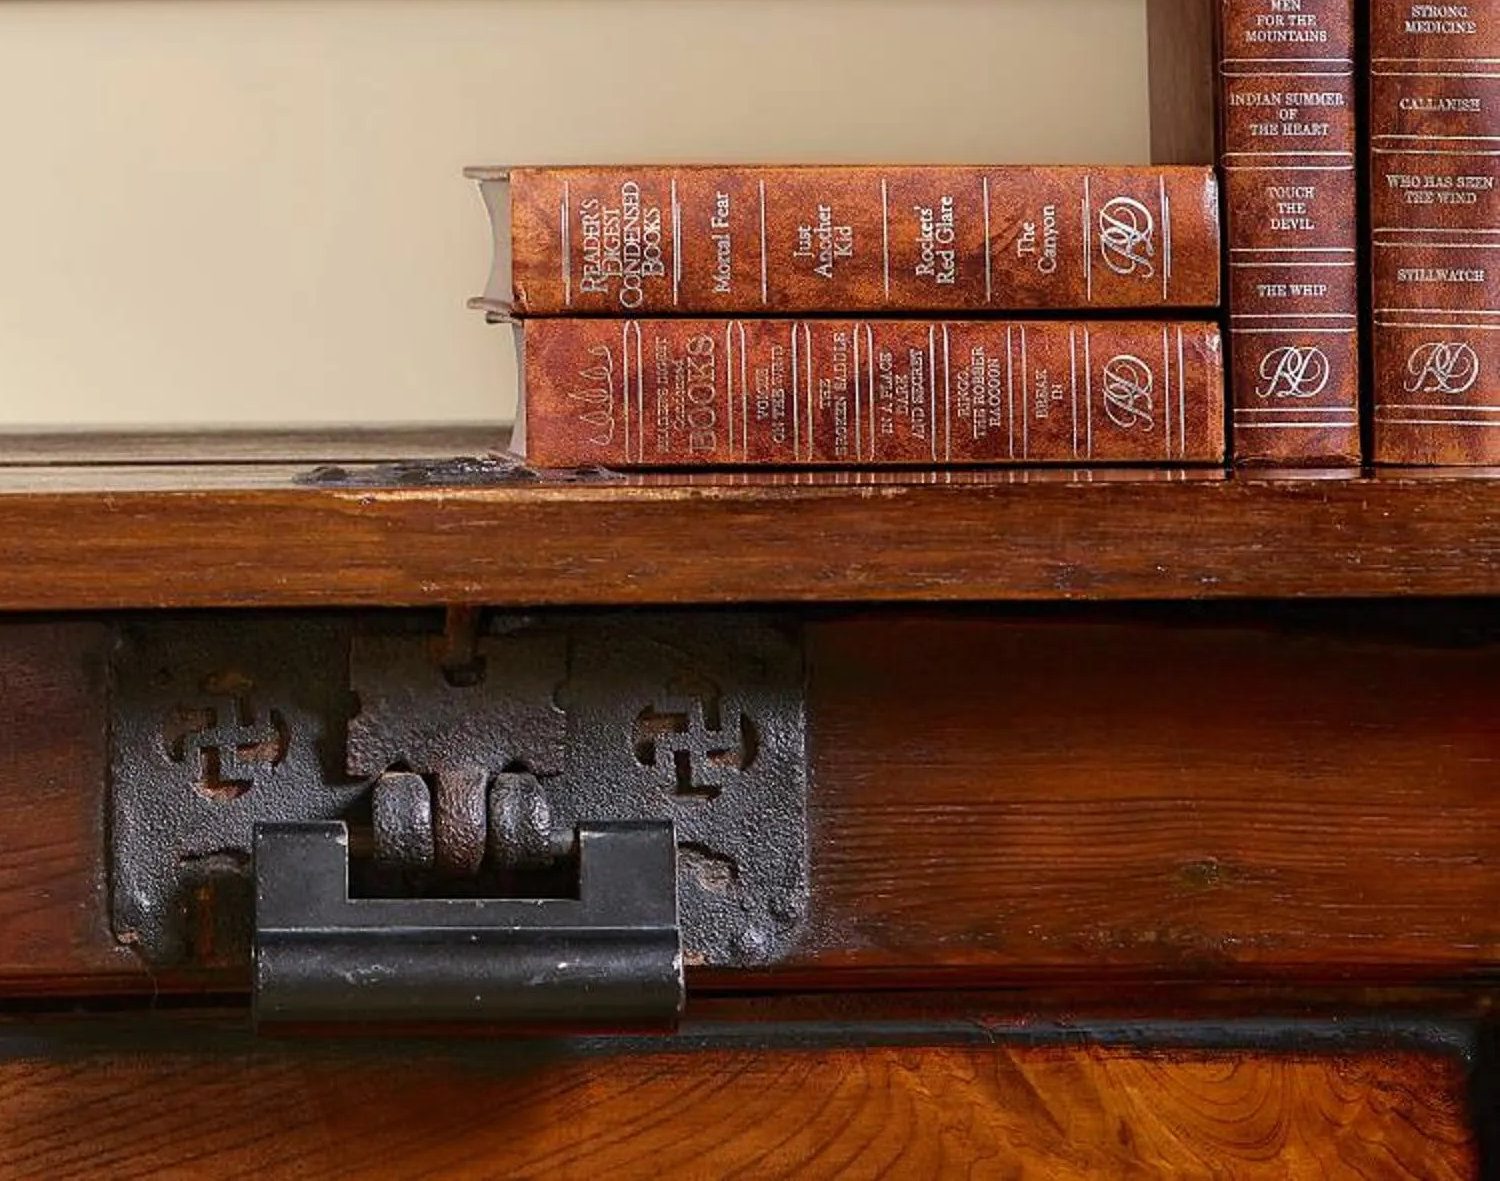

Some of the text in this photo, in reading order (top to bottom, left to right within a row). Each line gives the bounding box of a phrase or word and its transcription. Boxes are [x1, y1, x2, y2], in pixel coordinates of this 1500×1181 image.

[1257, 15, 1316, 26] FOR THE
[1271, 0, 1301, 11] MEN
[1411, 5, 1468, 18] STRONG
[1245, 30, 1327, 42] MOUNTAINS
[1405, 22, 1476, 34] MEDICINE
[1230, 93, 1344, 106] INDIAN SUMMER
[1279, 109, 1297, 121] OF
[1399, 99, 1481, 112] CALLANISH
[1249, 123, 1329, 136] THE HEART
[1267, 187, 1315, 199] TOUCH
[1386, 175, 1493, 189] WHO HAS SEEN
[1405, 191, 1477, 204] THE WIND
[1270, 219, 1314, 229] DEVIL
[1277, 203, 1305, 214] THE
[580, 198, 610, 293] READER'S
[602, 206, 623, 277] DIGEST
[620, 181, 643, 307] CONDENSED
[641, 207, 665, 277] BOOKS
[711, 191, 731, 293] Mortal Fear
[793, 225, 814, 258] Just
[814, 204, 833, 278] Another
[834, 226, 853, 256] Kid
[914, 206, 935, 275] Rockets'
[936, 196, 955, 284] Red Glare
[1017, 222, 1036, 258] The
[1038, 205, 1059, 273] Canyon
[1257, 285, 1327, 296] THE WHIP
[1397, 269, 1485, 281] STILLWATCH
[687, 334, 716, 454] BOOKS
[756, 368, 770, 420] VOICES
[772, 389, 785, 418] THE
[819, 378, 831, 409] THE
[833, 333, 848, 456] BROKEN SADDLE
[880, 351, 893, 434] IN A PLACE
[895, 374, 909, 416] DARK
[910, 349, 925, 439] AND SECRET
[971, 346, 986, 439] THE ROBBER
[988, 358, 1001, 427] RACCOON
[1036, 368, 1048, 418] BREAK
[1051, 384, 1063, 400] IN
[771, 422, 785, 443] ON
